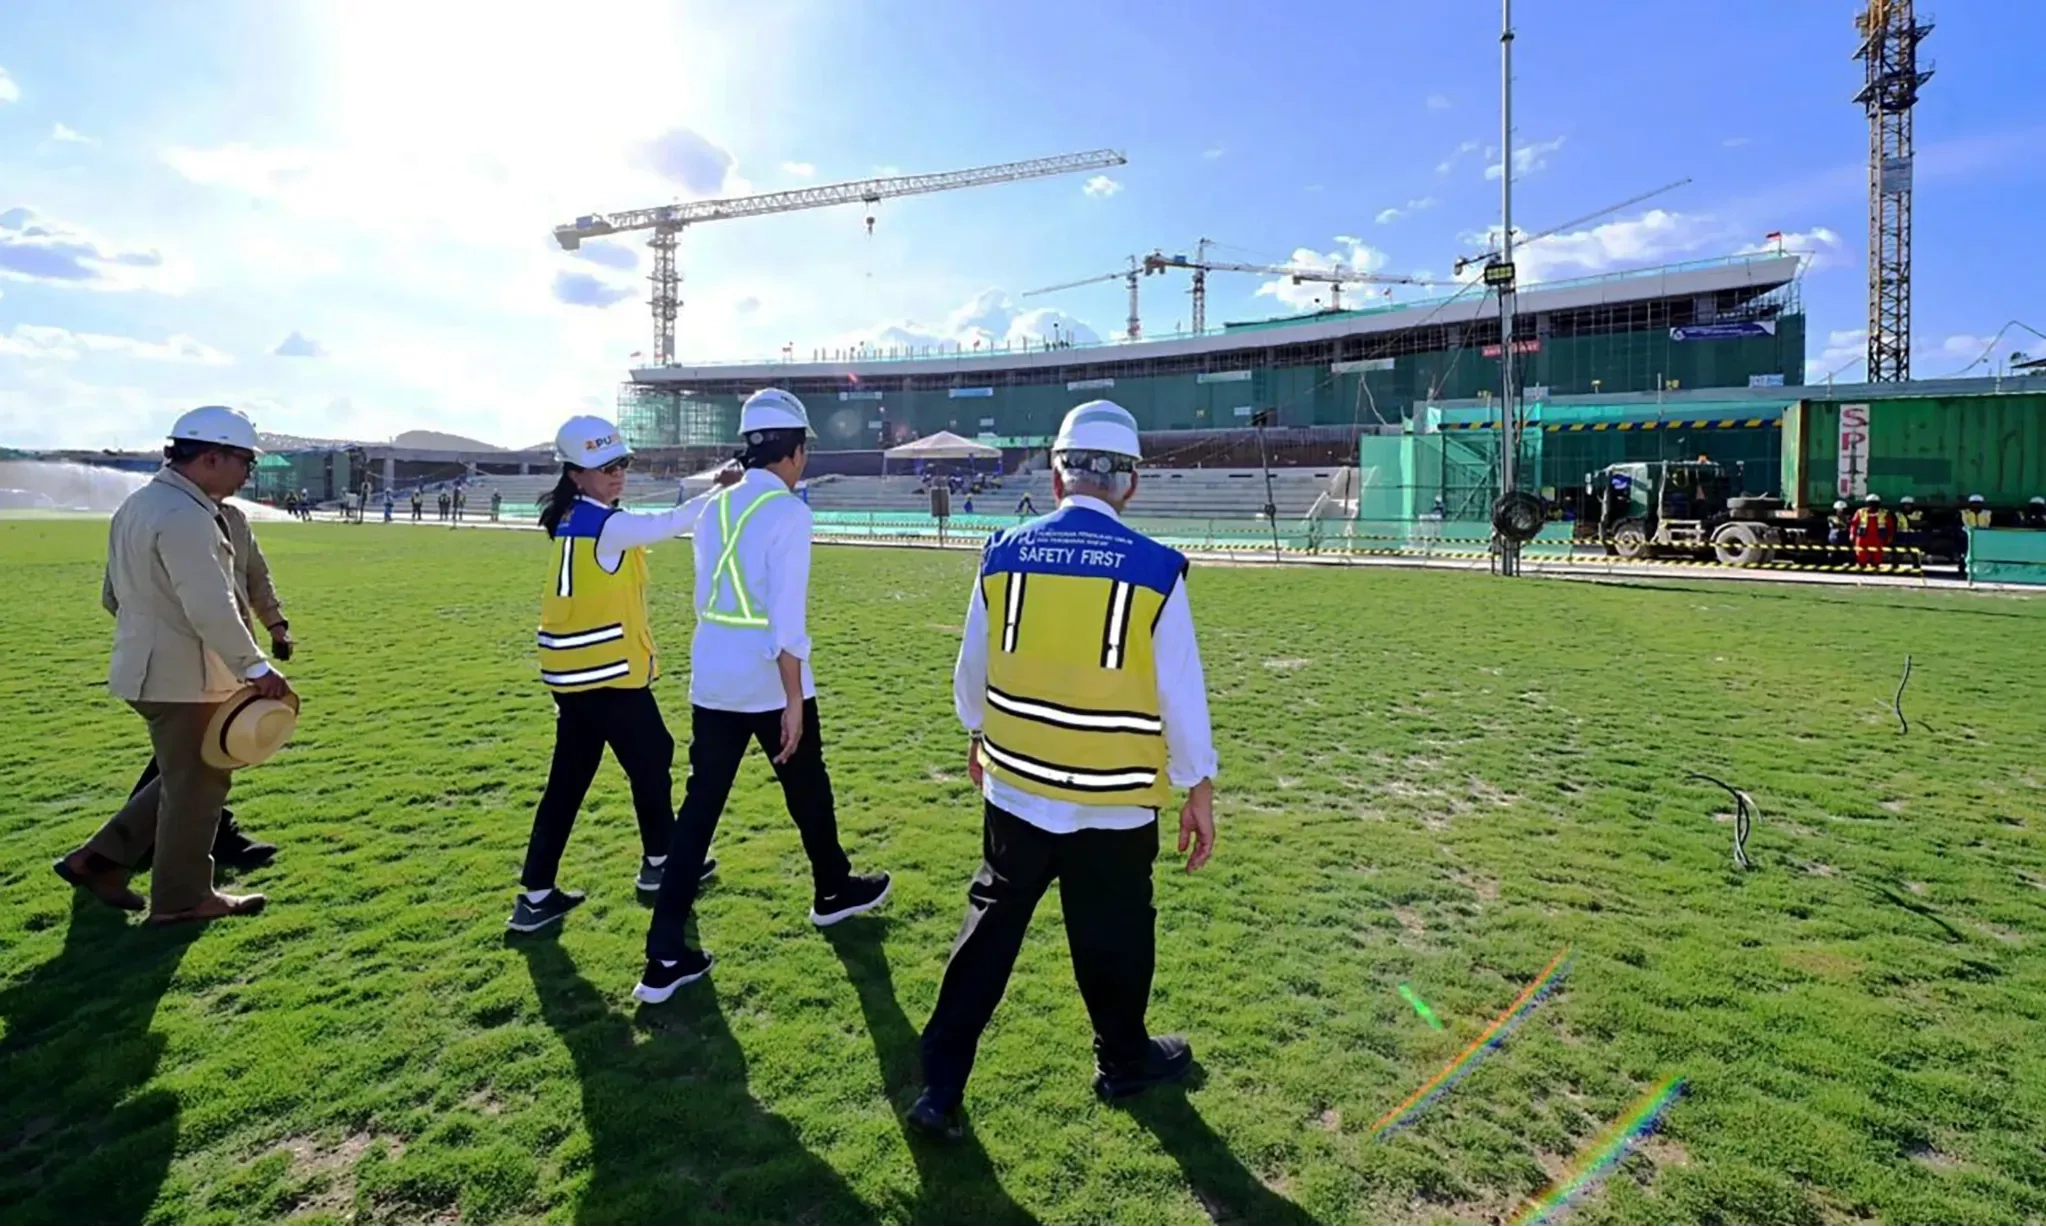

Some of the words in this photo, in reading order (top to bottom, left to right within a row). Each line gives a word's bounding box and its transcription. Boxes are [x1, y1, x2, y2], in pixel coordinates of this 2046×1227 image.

[595, 435, 612, 447] PU
[1019, 546, 1075, 564] SAFETY
[1080, 549, 1126, 568] FIRST
